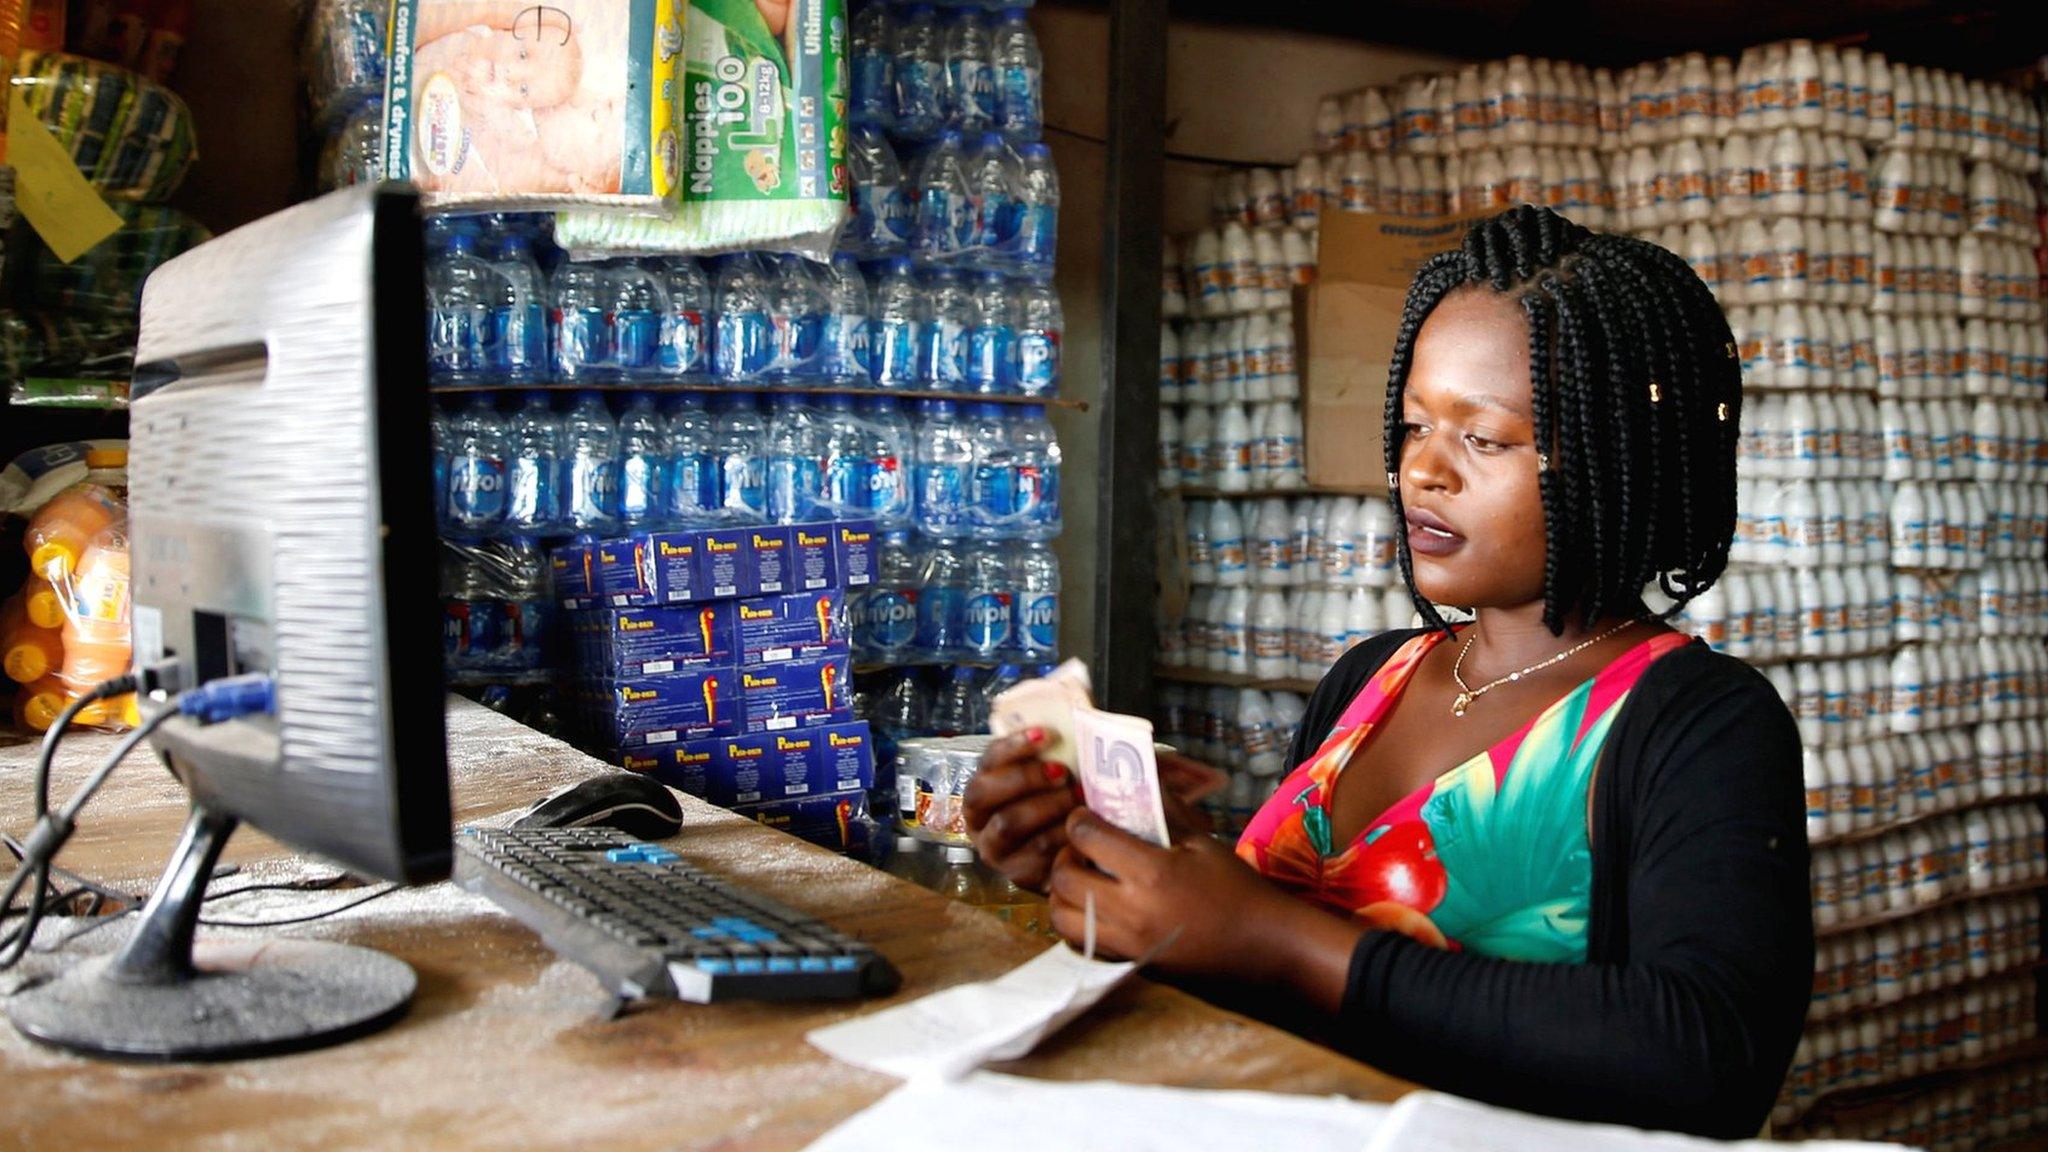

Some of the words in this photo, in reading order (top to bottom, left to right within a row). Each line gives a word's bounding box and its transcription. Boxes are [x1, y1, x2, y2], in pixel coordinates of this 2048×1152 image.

[393, 5, 410, 85] comfort
[804, 0, 821, 55] Ultim
[392, 87, 407, 102] &
[715, 56, 747, 126] 100
[758, 66, 774, 114] 8-12kg
[388, 104, 407, 180] dryness
[689, 82, 719, 193] Nappies
[1094, 735, 1146, 786] 5
